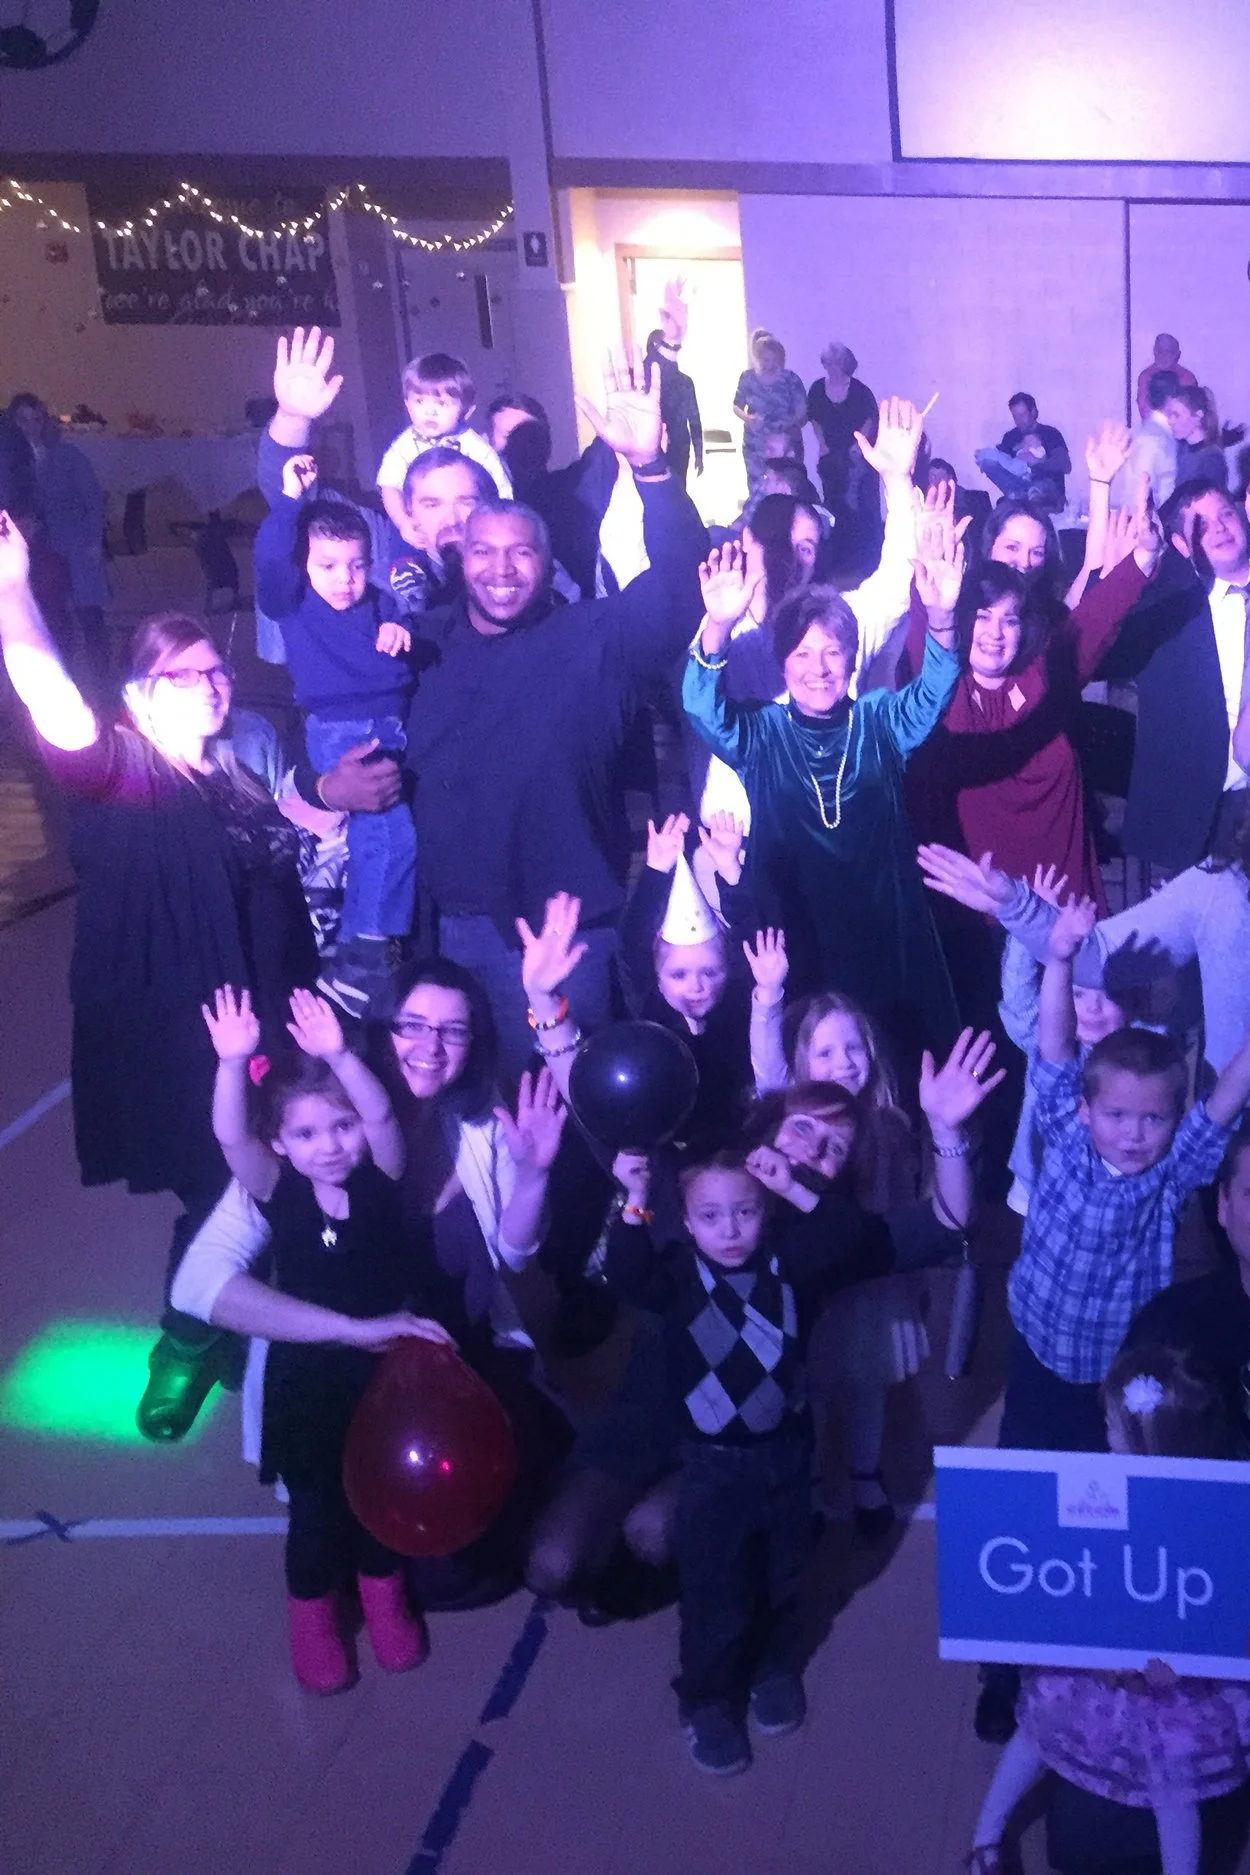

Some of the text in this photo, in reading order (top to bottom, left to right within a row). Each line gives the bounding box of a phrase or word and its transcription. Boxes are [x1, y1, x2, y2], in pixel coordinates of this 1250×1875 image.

[101, 228, 228, 271] TAYLOR
[979, 1537, 1213, 1619] Got Up
